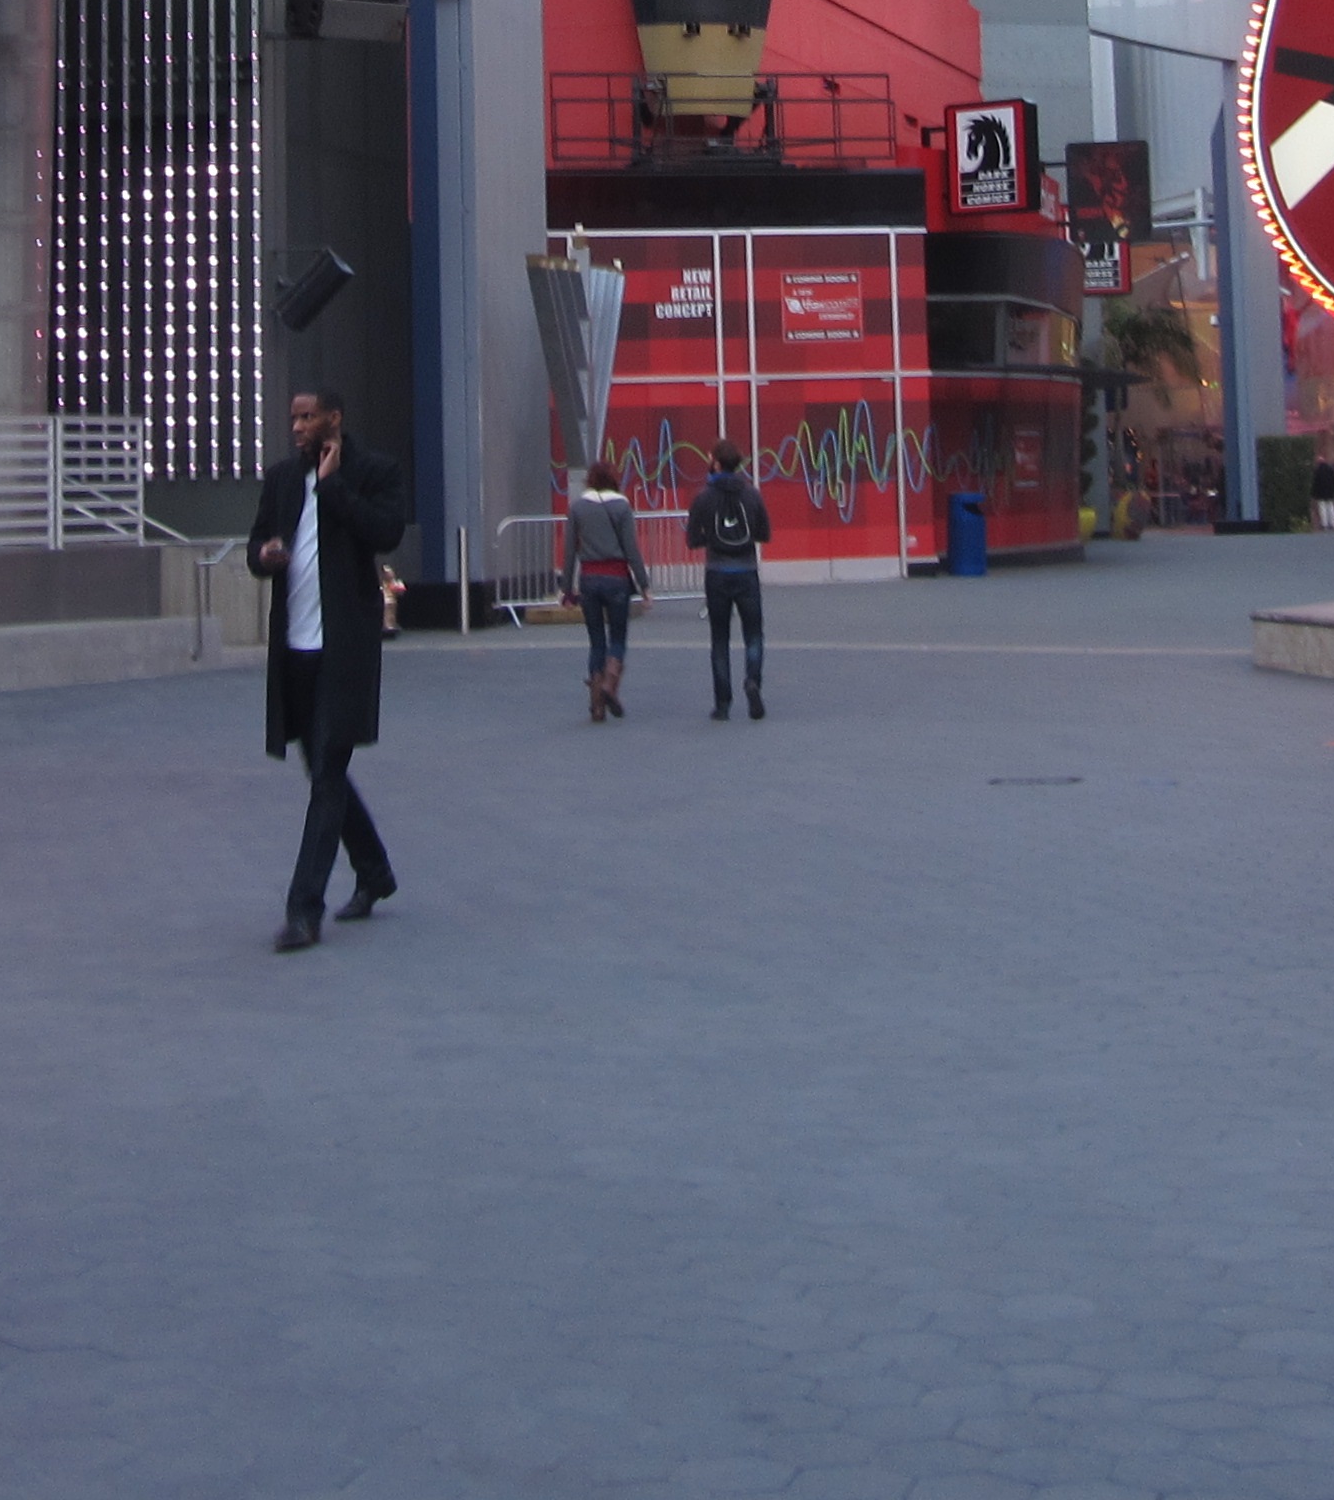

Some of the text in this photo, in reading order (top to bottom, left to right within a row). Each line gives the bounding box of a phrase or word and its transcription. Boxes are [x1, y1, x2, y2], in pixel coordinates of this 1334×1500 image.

[978, 169, 1009, 181] DARK
[972, 181, 1009, 192] HORSE
[966, 194, 1011, 206] COMICS
[682, 268, 711, 285] NEW
[1085, 270, 1114, 278] ORSE
[1084, 279, 1115, 288] OMICS
[670, 285, 713, 302] RETAIL
[655, 302, 713, 319] CONCEPT
